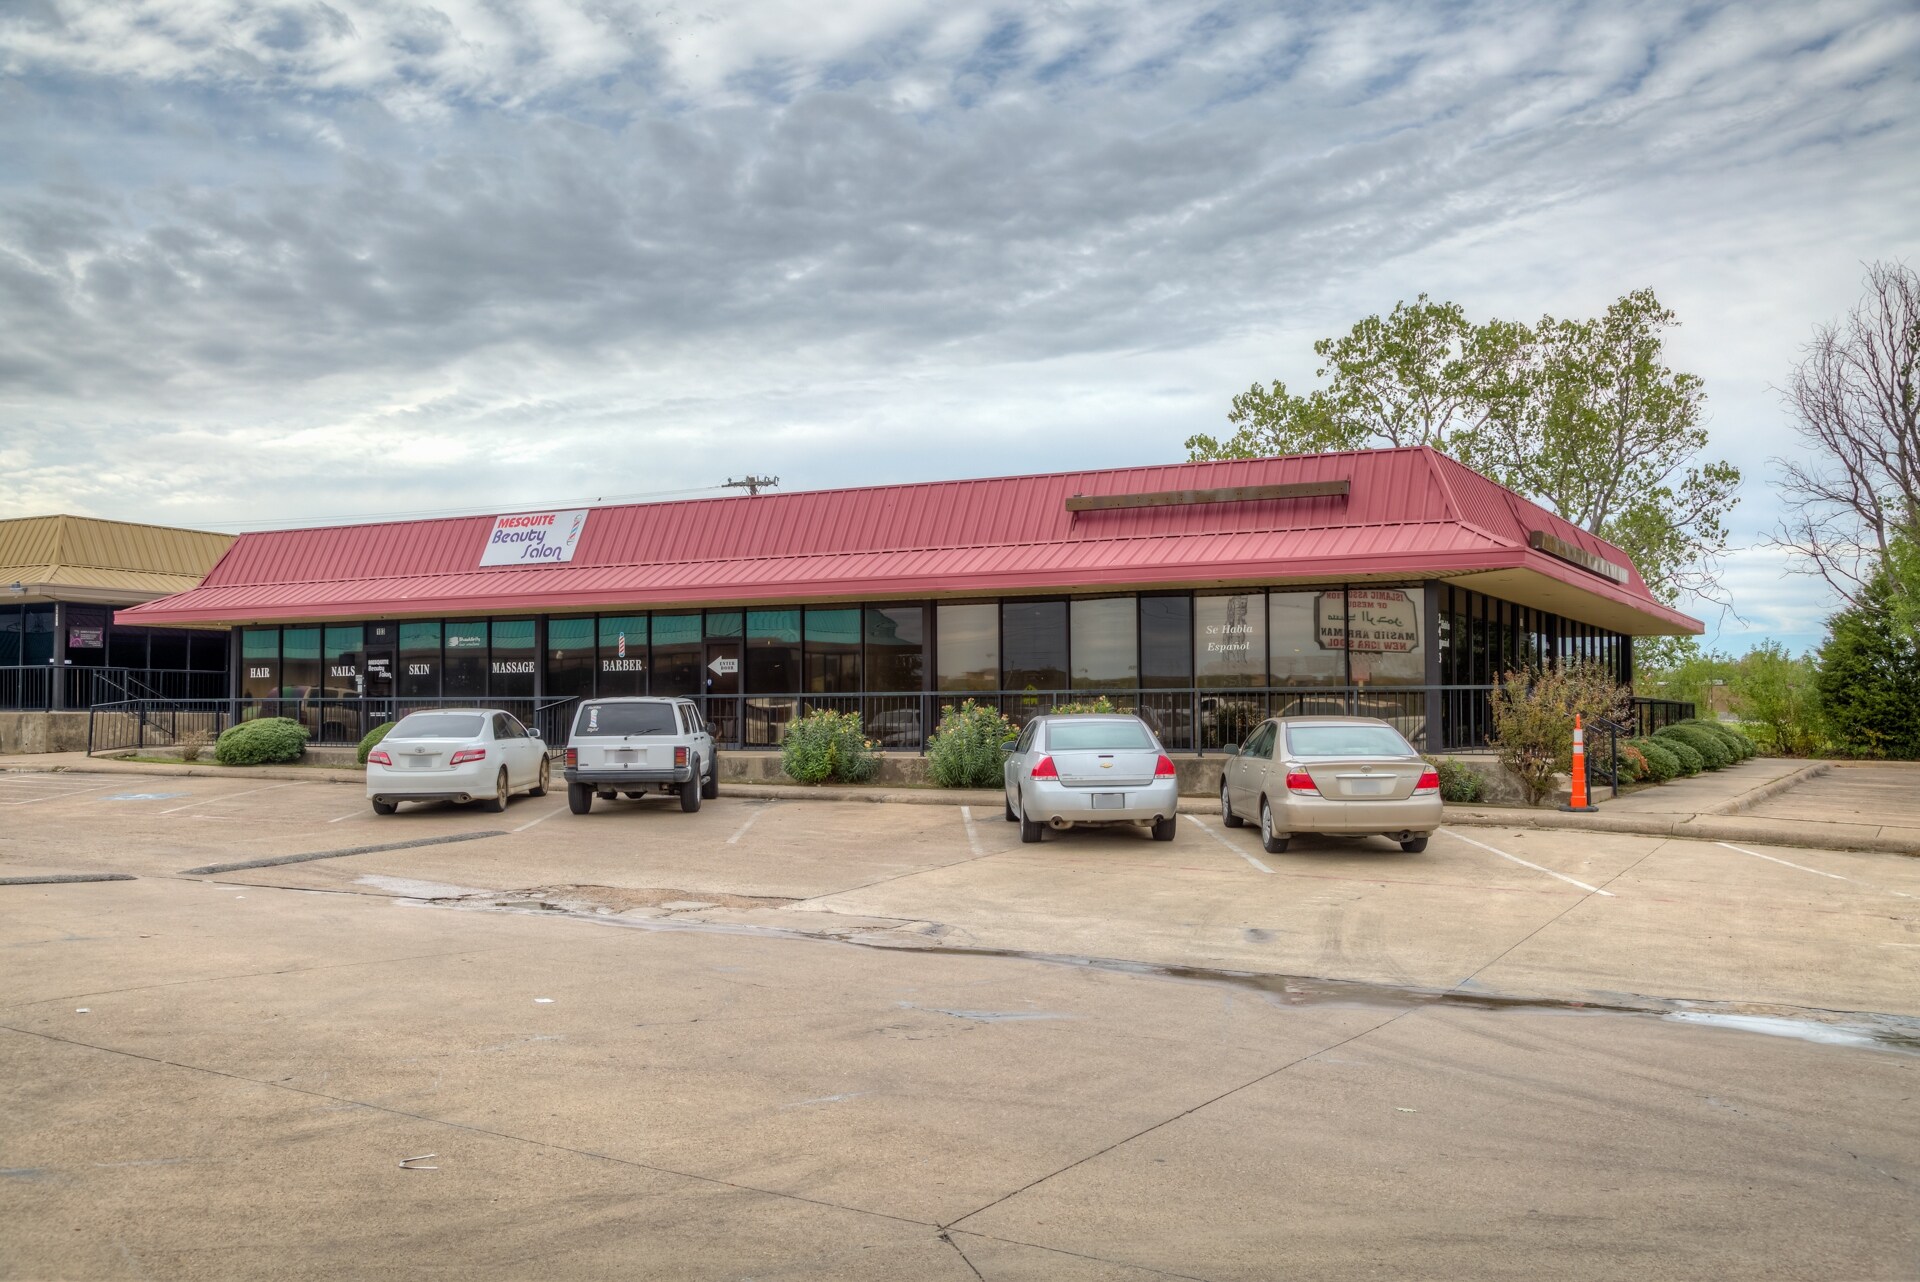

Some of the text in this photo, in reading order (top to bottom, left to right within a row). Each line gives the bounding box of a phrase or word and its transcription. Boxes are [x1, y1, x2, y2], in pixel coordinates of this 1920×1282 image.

[498, 515, 555, 528] MESQUITE
[492, 529, 546, 545] Beauty
[521, 544, 562, 560] Salon
[1206, 624, 1253, 634] Se Habla
[1208, 642, 1250, 652] Español
[331, 666, 355, 677] NAILS
[409, 664, 430, 675] SKIN
[492, 662, 535, 673] MASSAGE
[603, 660, 642, 672] BARBER
[250, 667, 270, 678] HAIR
